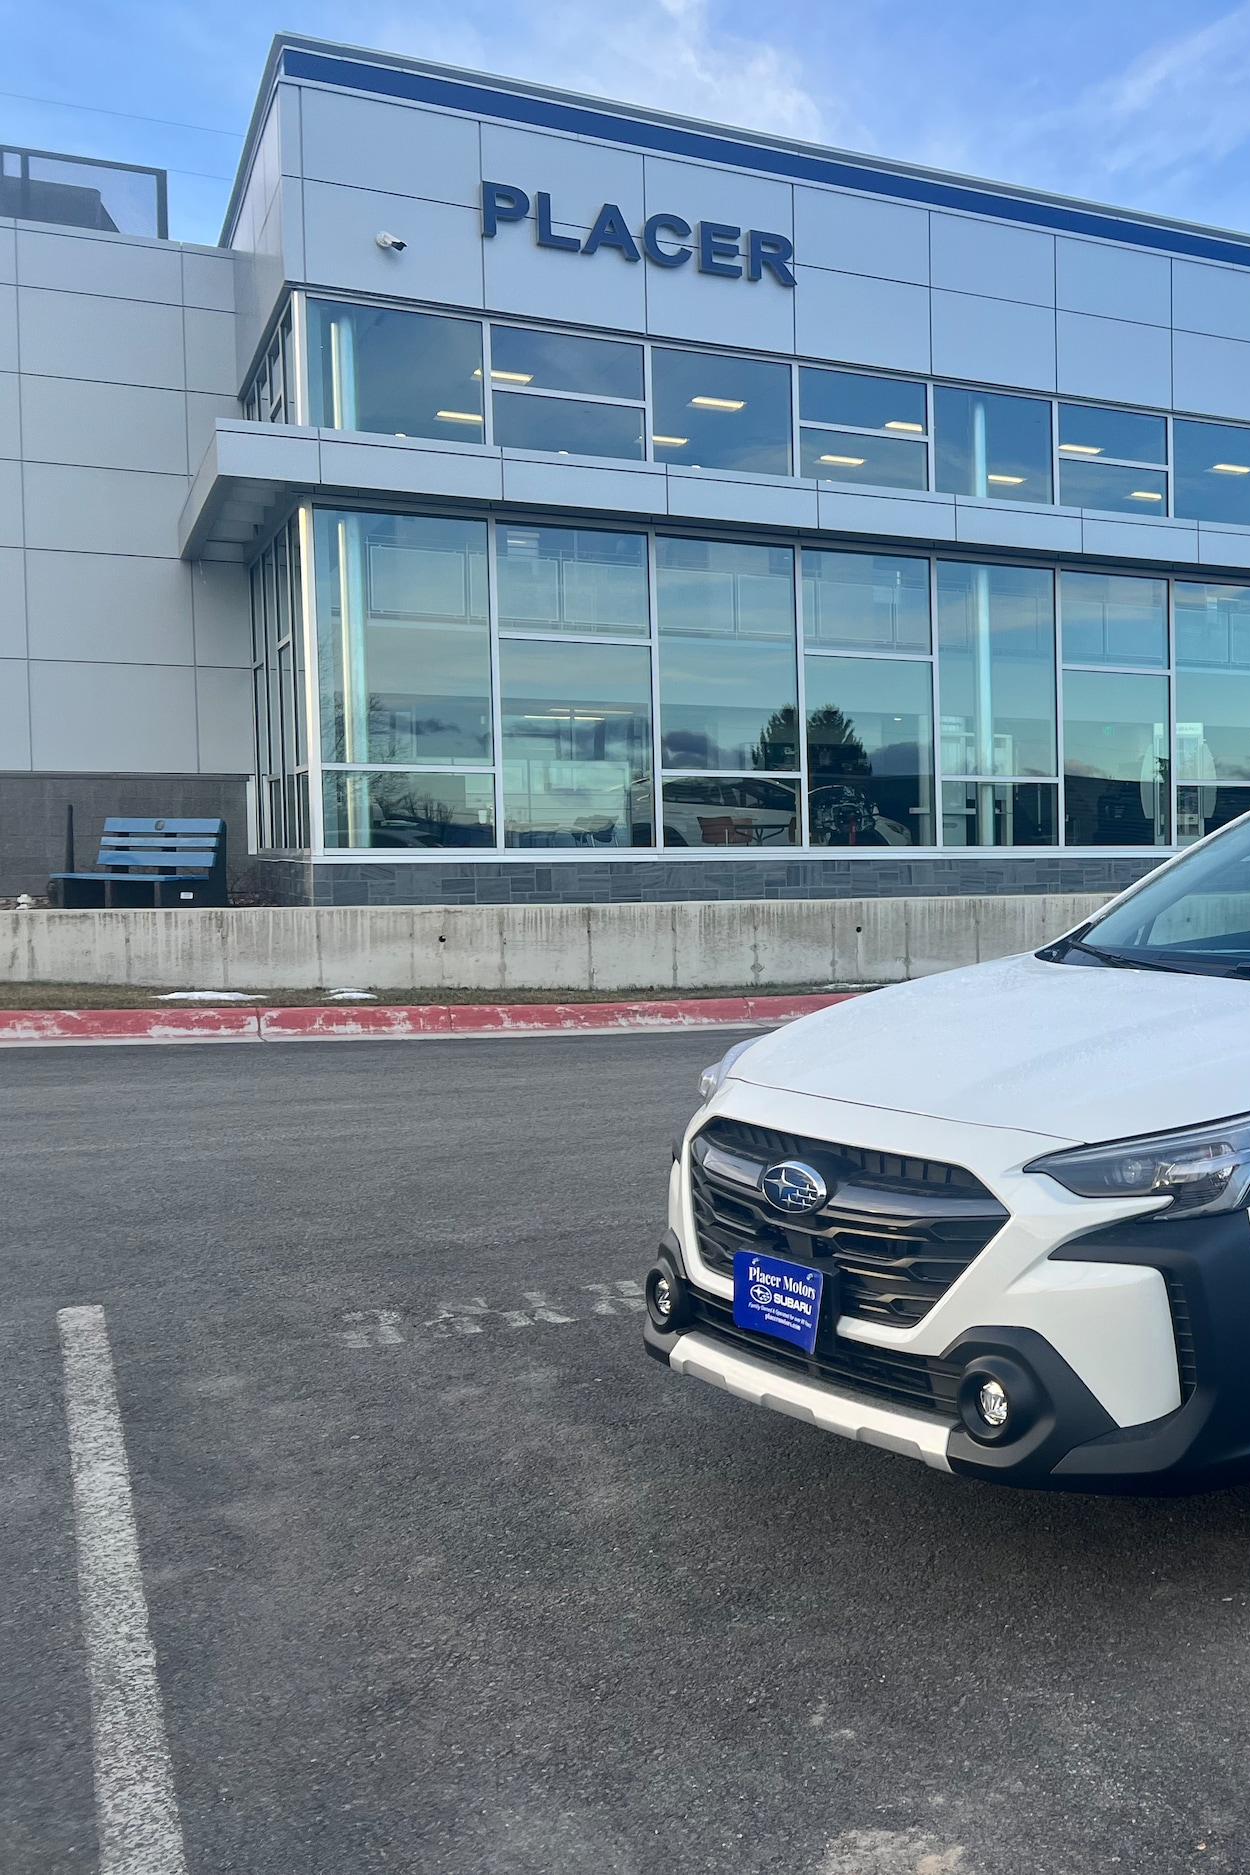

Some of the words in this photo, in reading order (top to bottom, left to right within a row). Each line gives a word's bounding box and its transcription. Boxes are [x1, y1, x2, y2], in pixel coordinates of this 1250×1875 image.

[480, 179, 798, 288] PLACER
[748, 1266, 782, 1289] Placer
[783, 1275, 817, 1301] Motors
[773, 1292, 812, 1316] SUBARU
